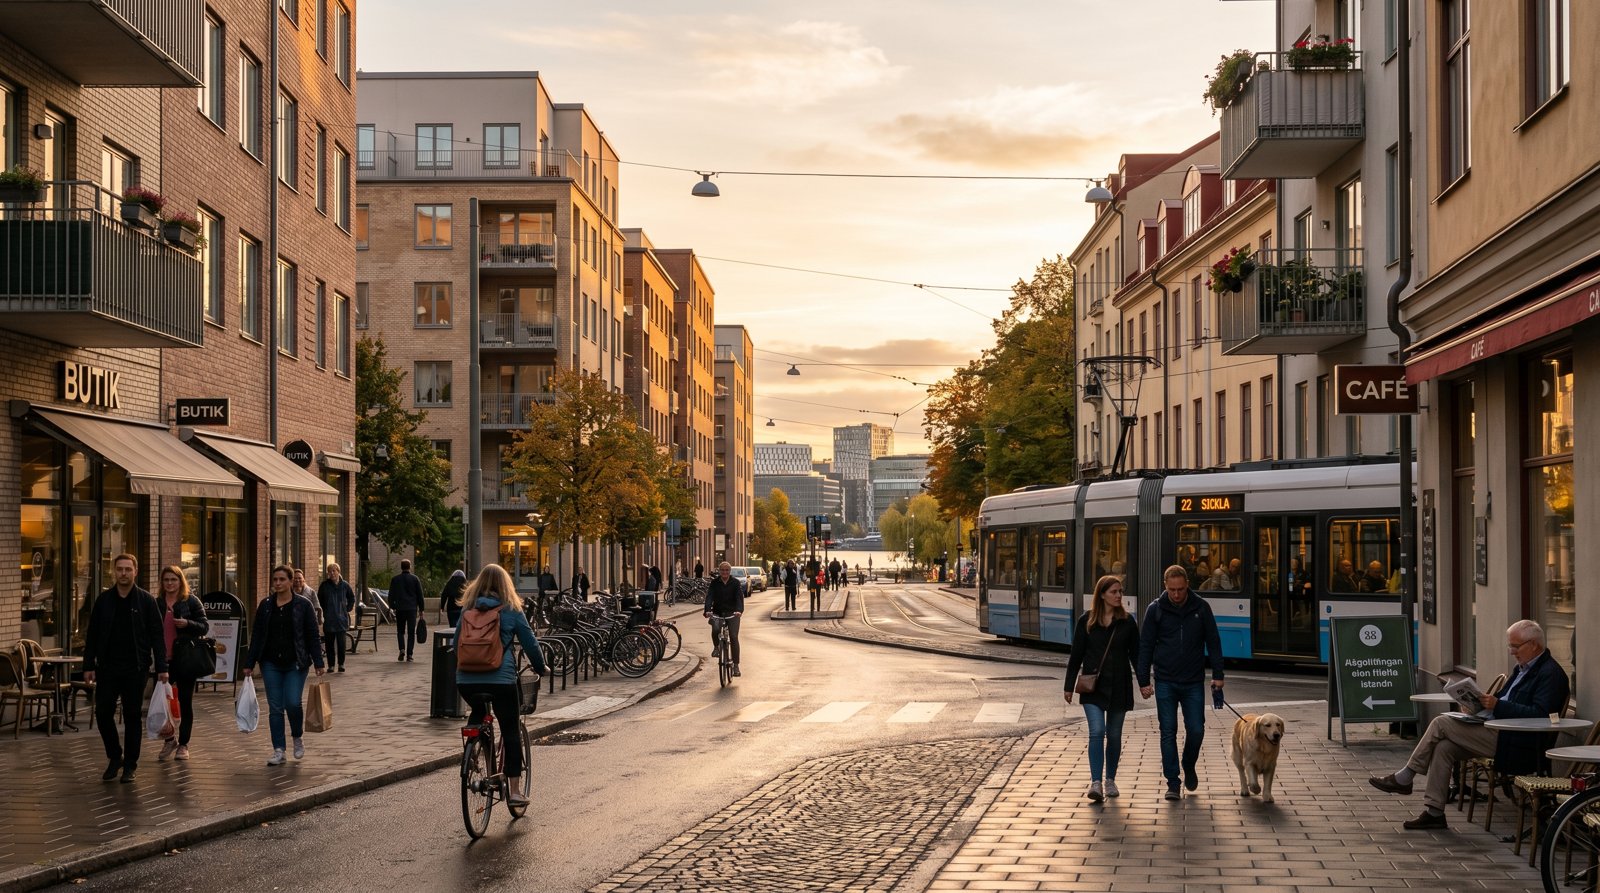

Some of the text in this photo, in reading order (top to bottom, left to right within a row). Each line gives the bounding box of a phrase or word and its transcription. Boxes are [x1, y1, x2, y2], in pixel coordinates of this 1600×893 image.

[1471, 337, 1485, 360] CAFÉ
[64, 362, 121, 409] BUTIK
[1346, 376, 1409, 400] CAFÉ
[181, 405, 225, 419] BUTIK
[286, 452, 309, 460] BUTIK
[1181, 497, 1230, 511] 22 SICKLA
